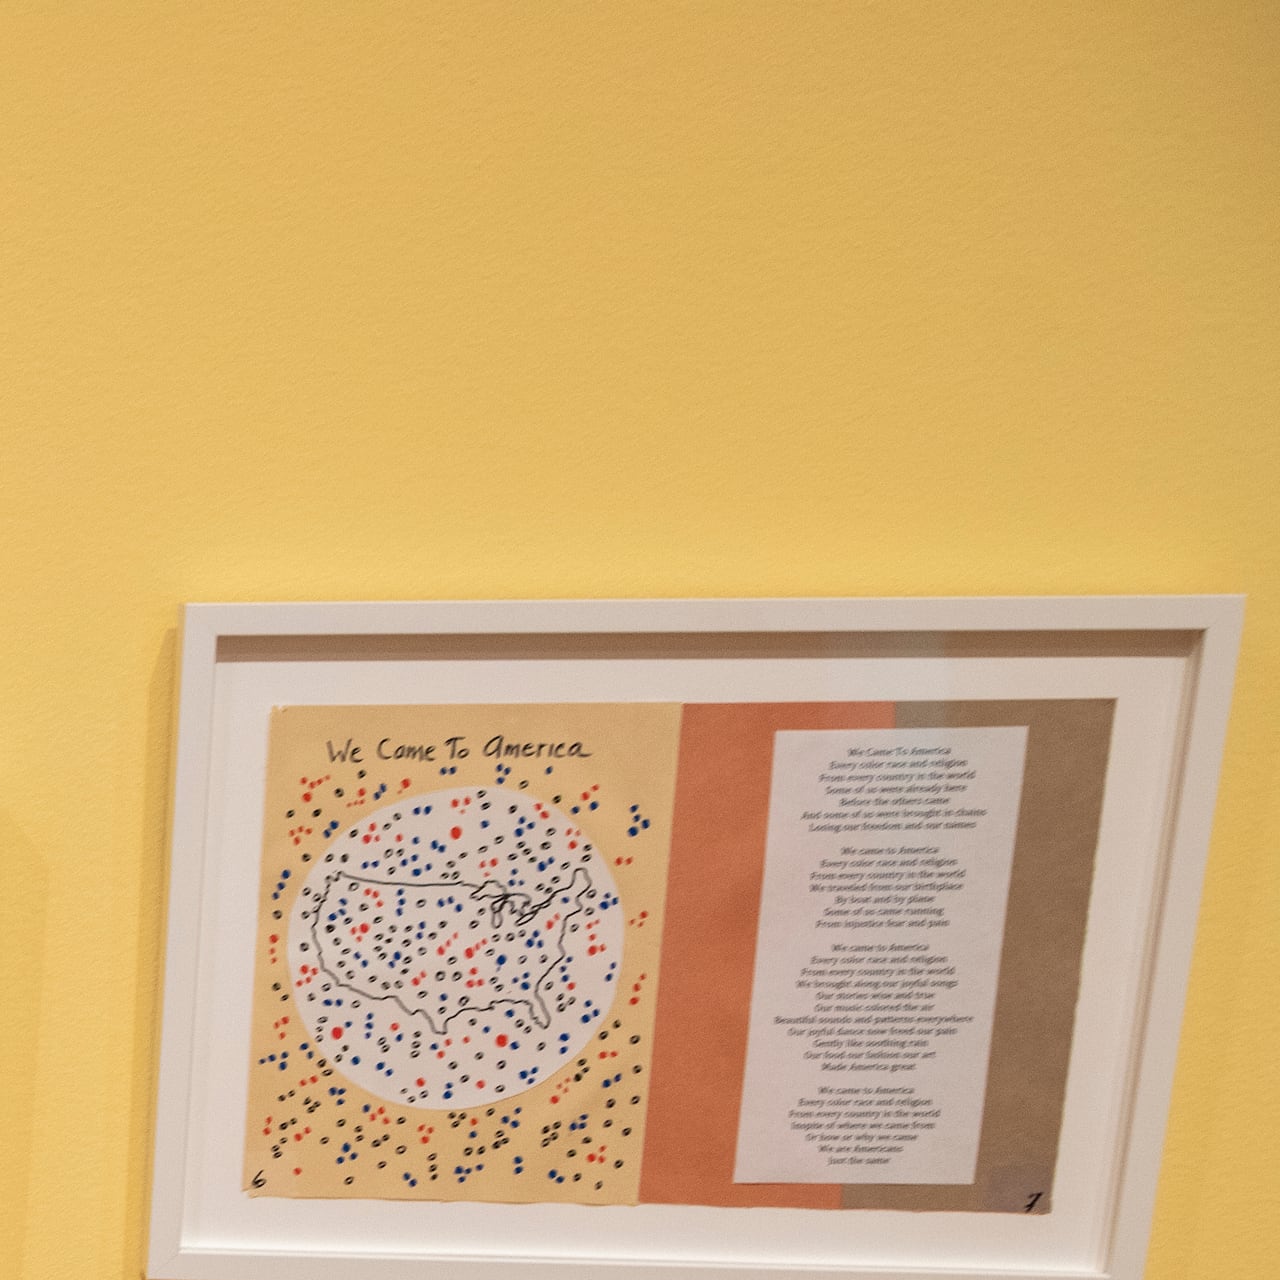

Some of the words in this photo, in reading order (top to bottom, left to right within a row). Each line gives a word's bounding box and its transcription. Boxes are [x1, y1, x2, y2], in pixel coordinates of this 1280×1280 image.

[326, 738, 365, 763] We
[376, 738, 437, 762] Came
[444, 736, 471, 760] To
[481, 735, 593, 759] America
[251, 1169, 267, 1189] 6
[1024, 1192, 1045, 1213] 7
